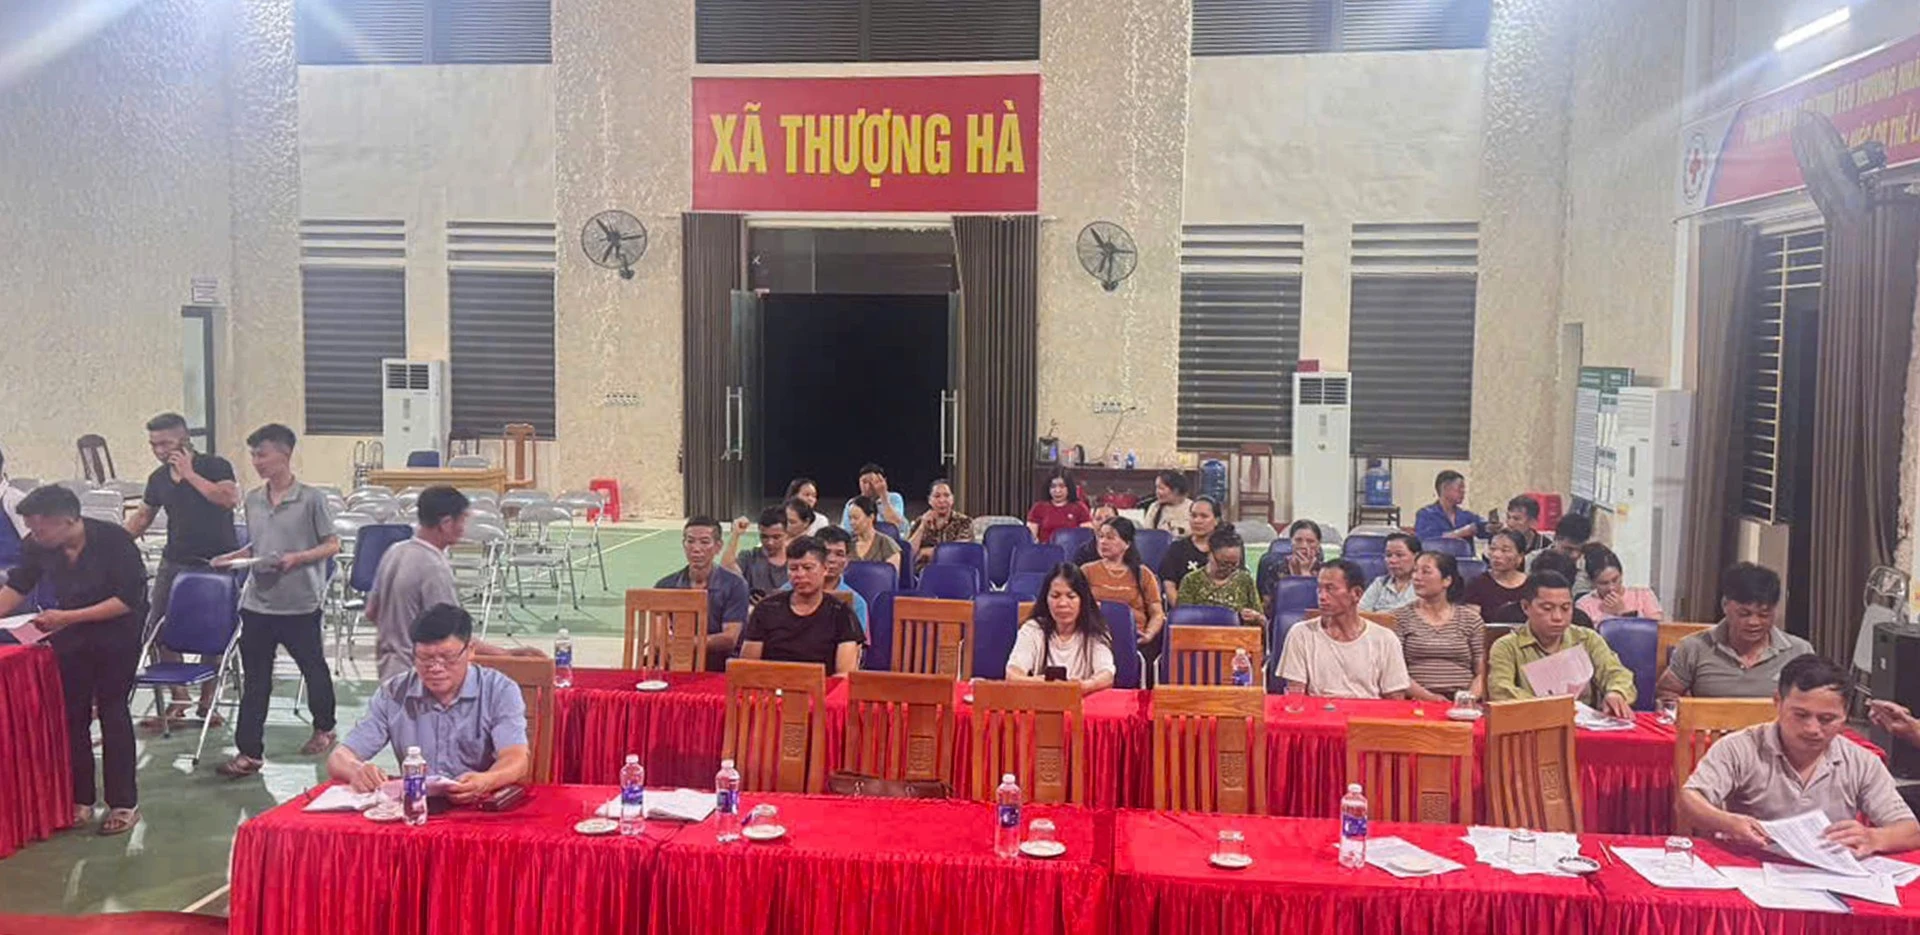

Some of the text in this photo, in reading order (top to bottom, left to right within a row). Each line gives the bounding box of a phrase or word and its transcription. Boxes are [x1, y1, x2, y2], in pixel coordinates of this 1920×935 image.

[710, 99, 1025, 188] XÃ THƯỢNG HÀ
